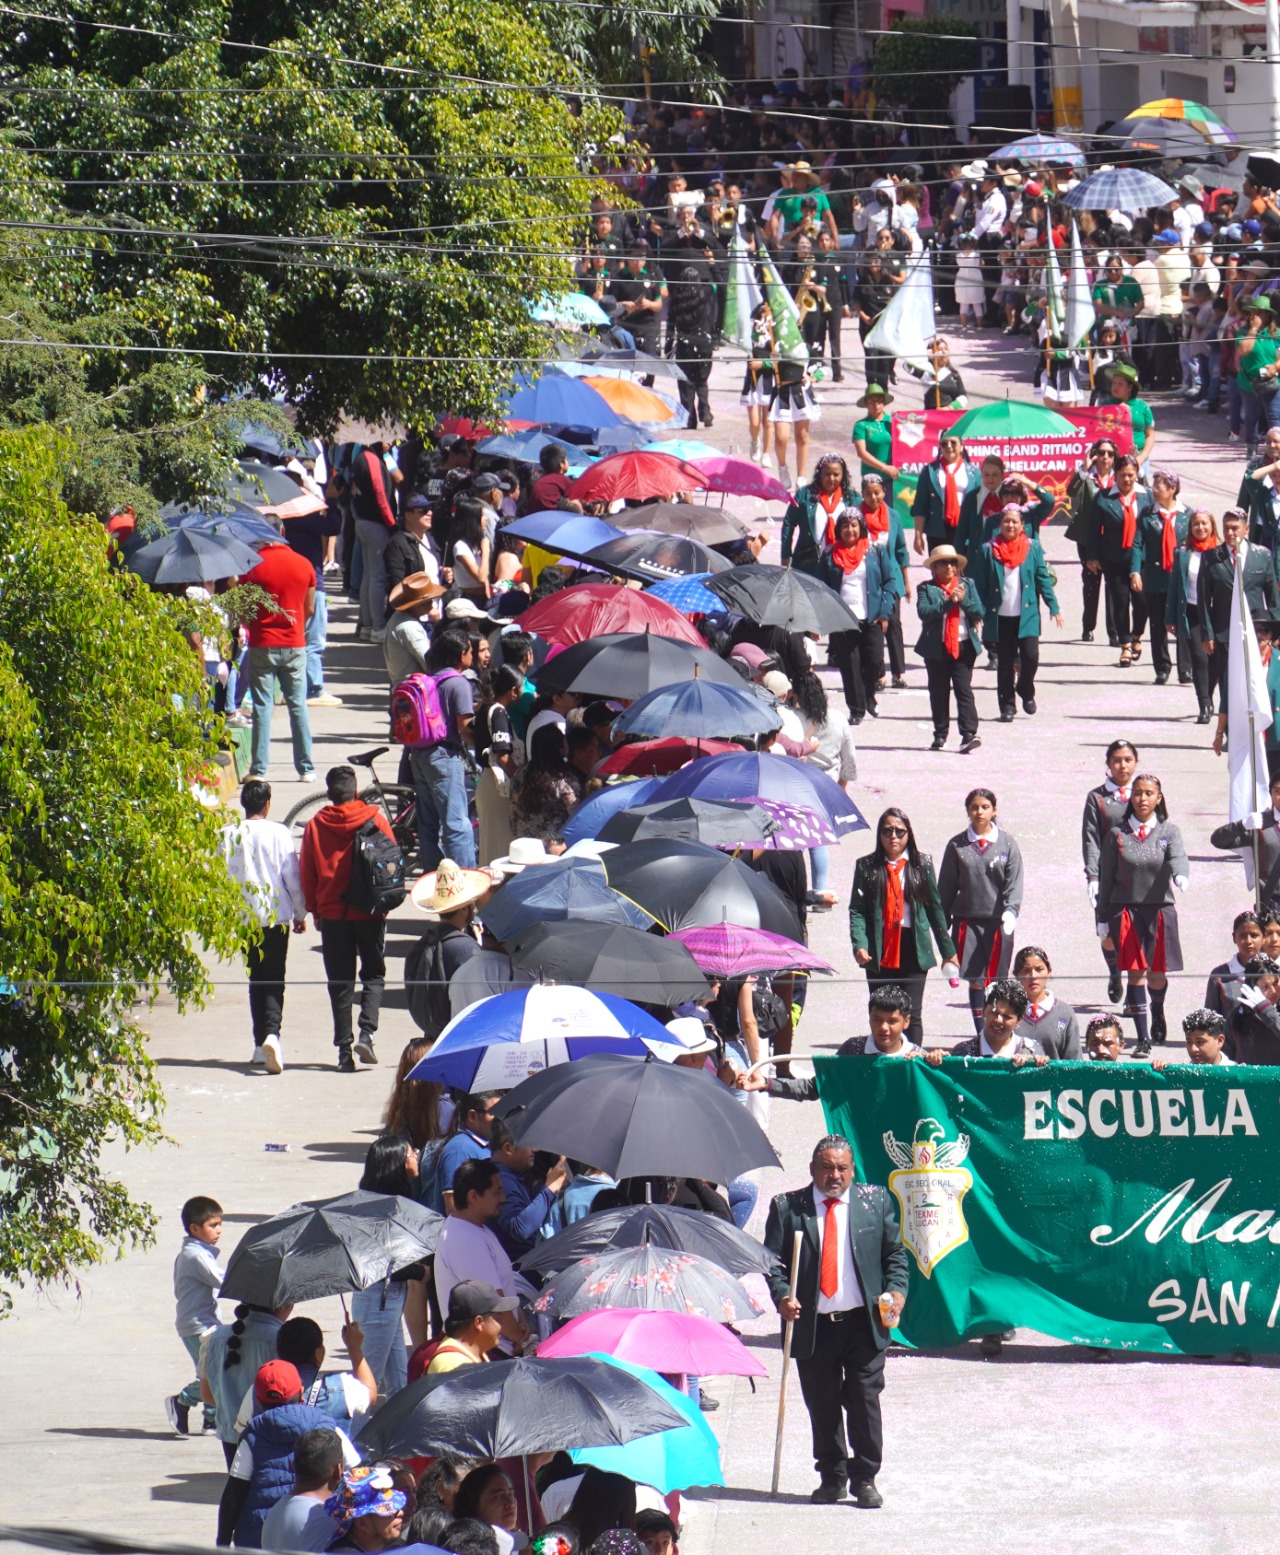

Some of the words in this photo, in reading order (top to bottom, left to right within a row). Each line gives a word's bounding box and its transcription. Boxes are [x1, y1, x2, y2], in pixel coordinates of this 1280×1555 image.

[1003, 444, 1040, 457] BAND
[1041, 442, 1083, 456] RITMO
[1022, 1088, 1258, 1141] ESCUELA
[921, 1193, 928, 1203] 2
[1147, 1277, 1251, 1326] SAN
